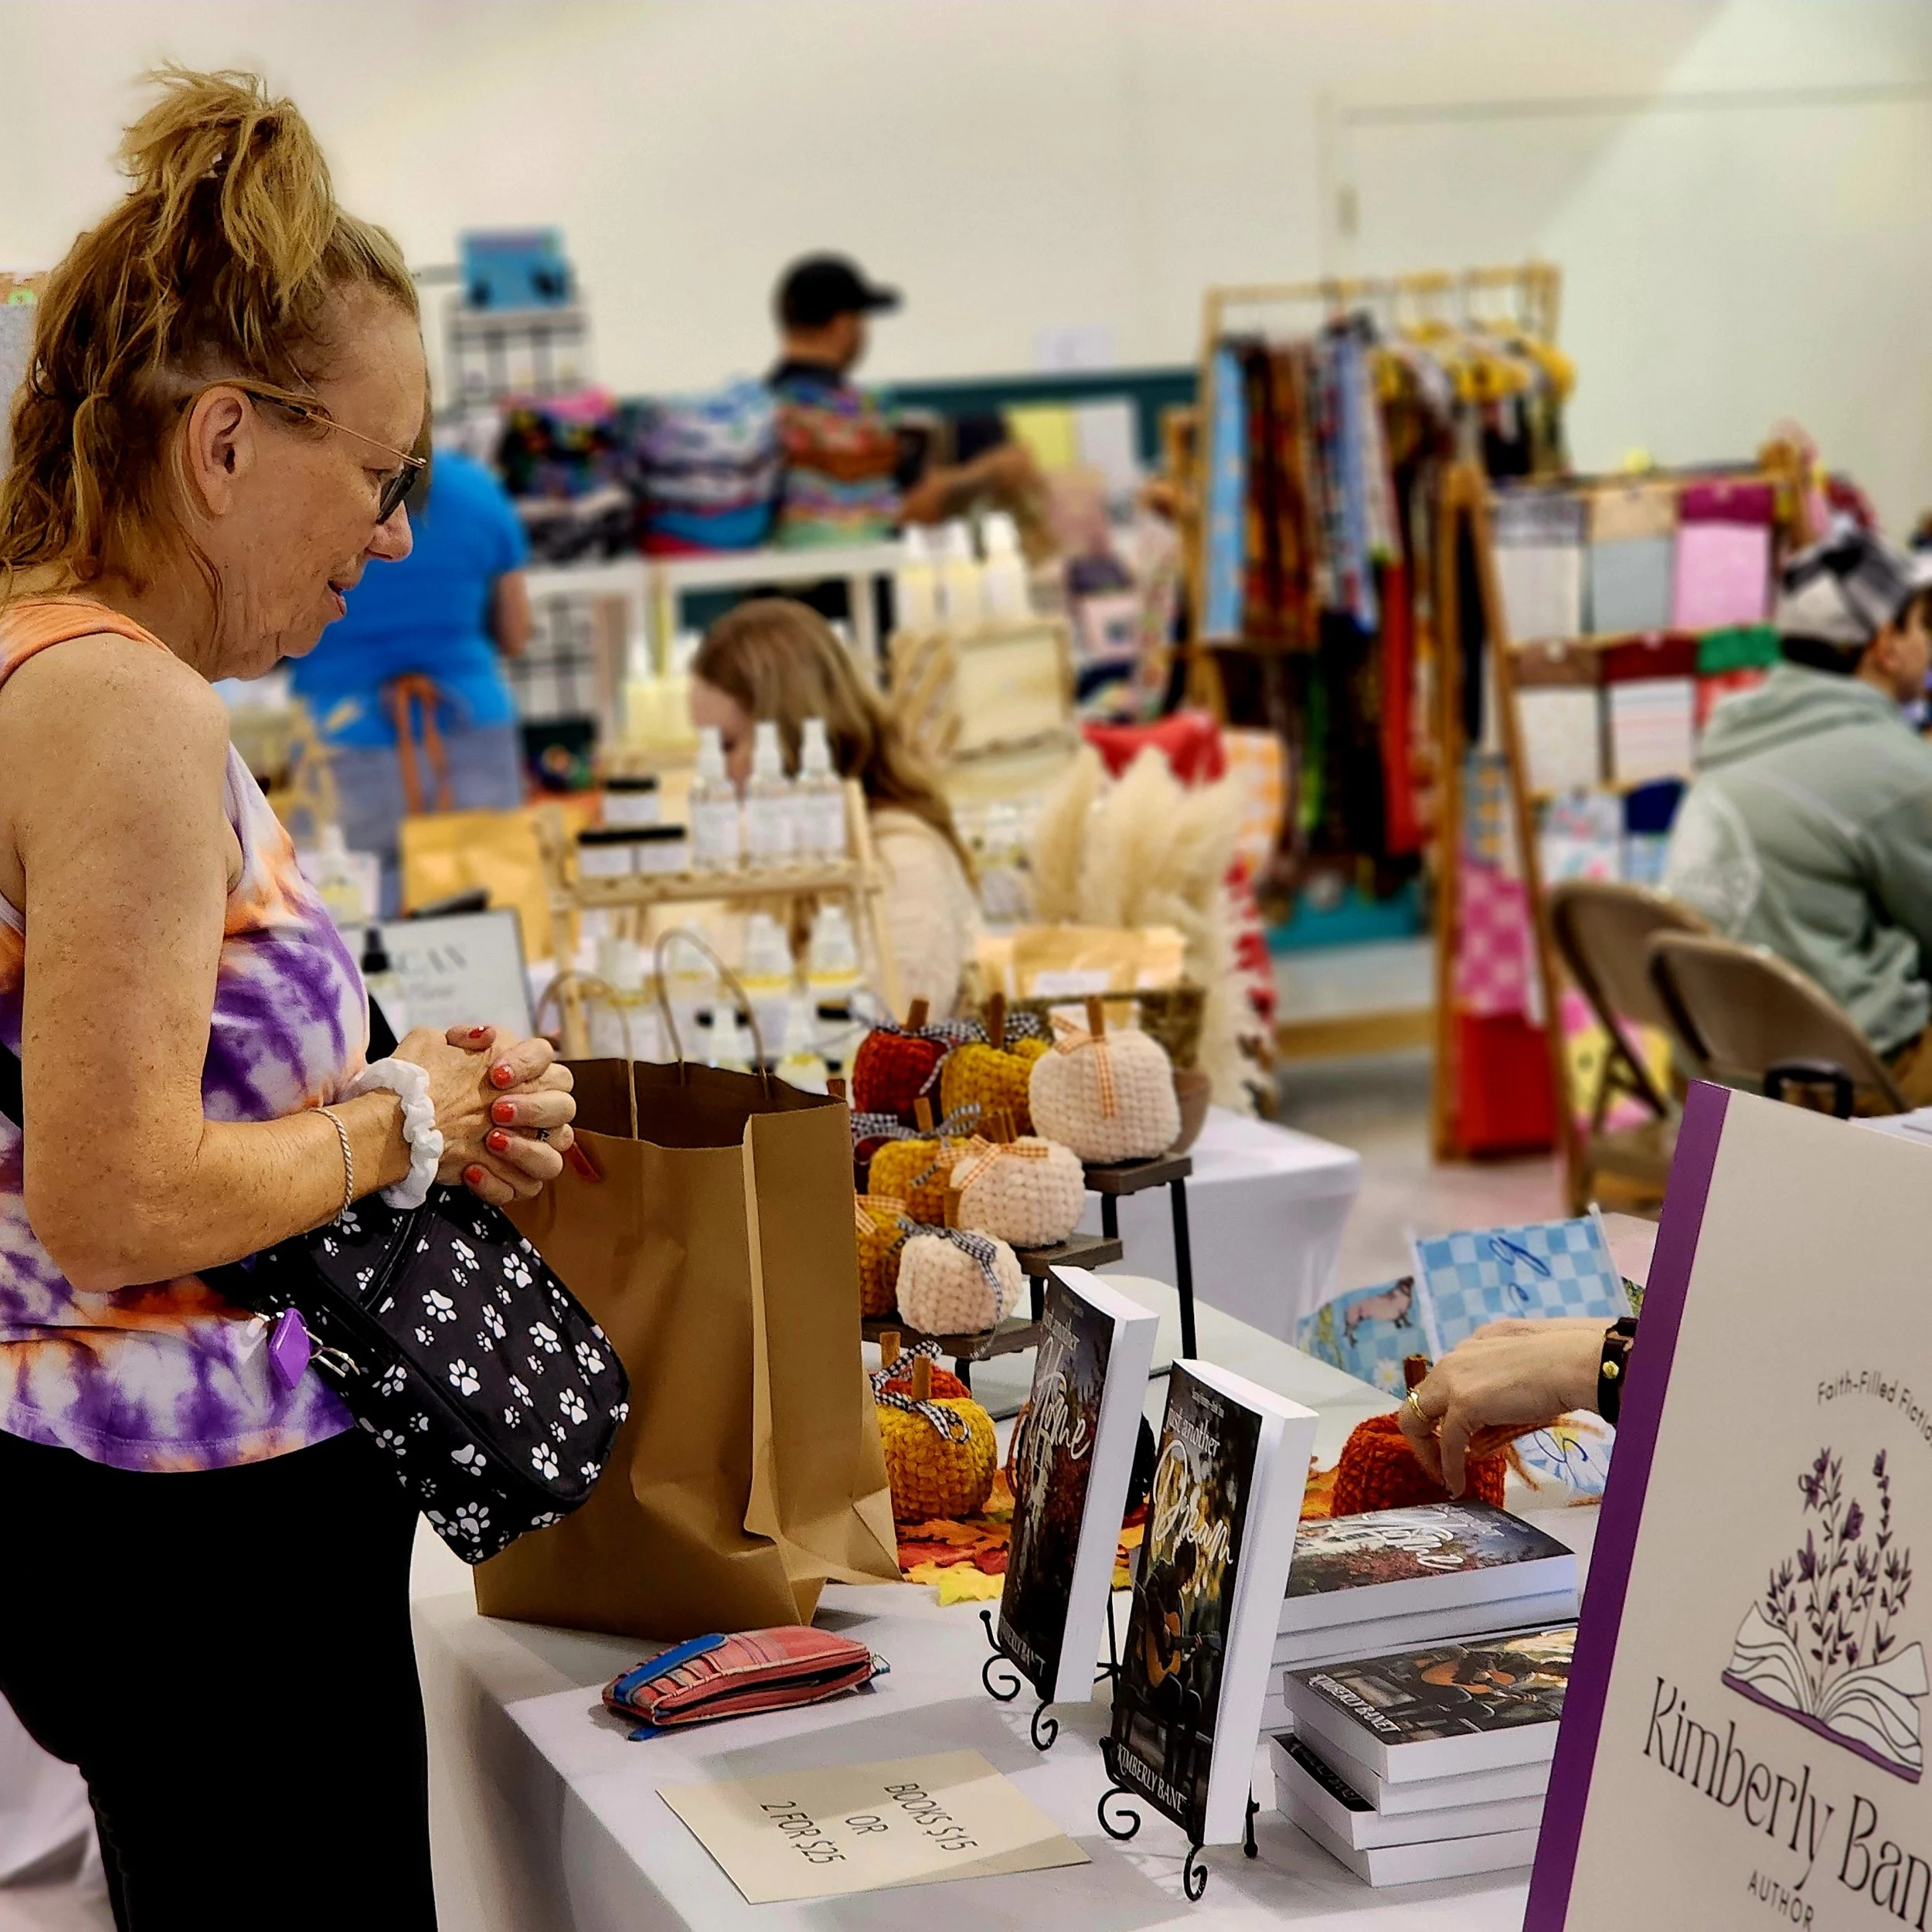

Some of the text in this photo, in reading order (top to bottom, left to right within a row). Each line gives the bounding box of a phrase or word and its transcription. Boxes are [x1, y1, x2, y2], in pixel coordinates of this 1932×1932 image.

[1182, 1418, 1220, 1458] another
[1818, 1370, 1932, 1450] Faith-Filled Fictio
[1151, 1439, 1233, 1564] Dream
[1117, 1743, 1189, 1815] KIMBERLY BANE
[1643, 1676, 1835, 1891] Kimberly
[760, 1801, 847, 1864] 2 FOR $25
[845, 1815, 889, 1835] OR
[884, 1782, 979, 1851] BOOKS $15
[1747, 1869, 1815, 1932] AUTHOR
